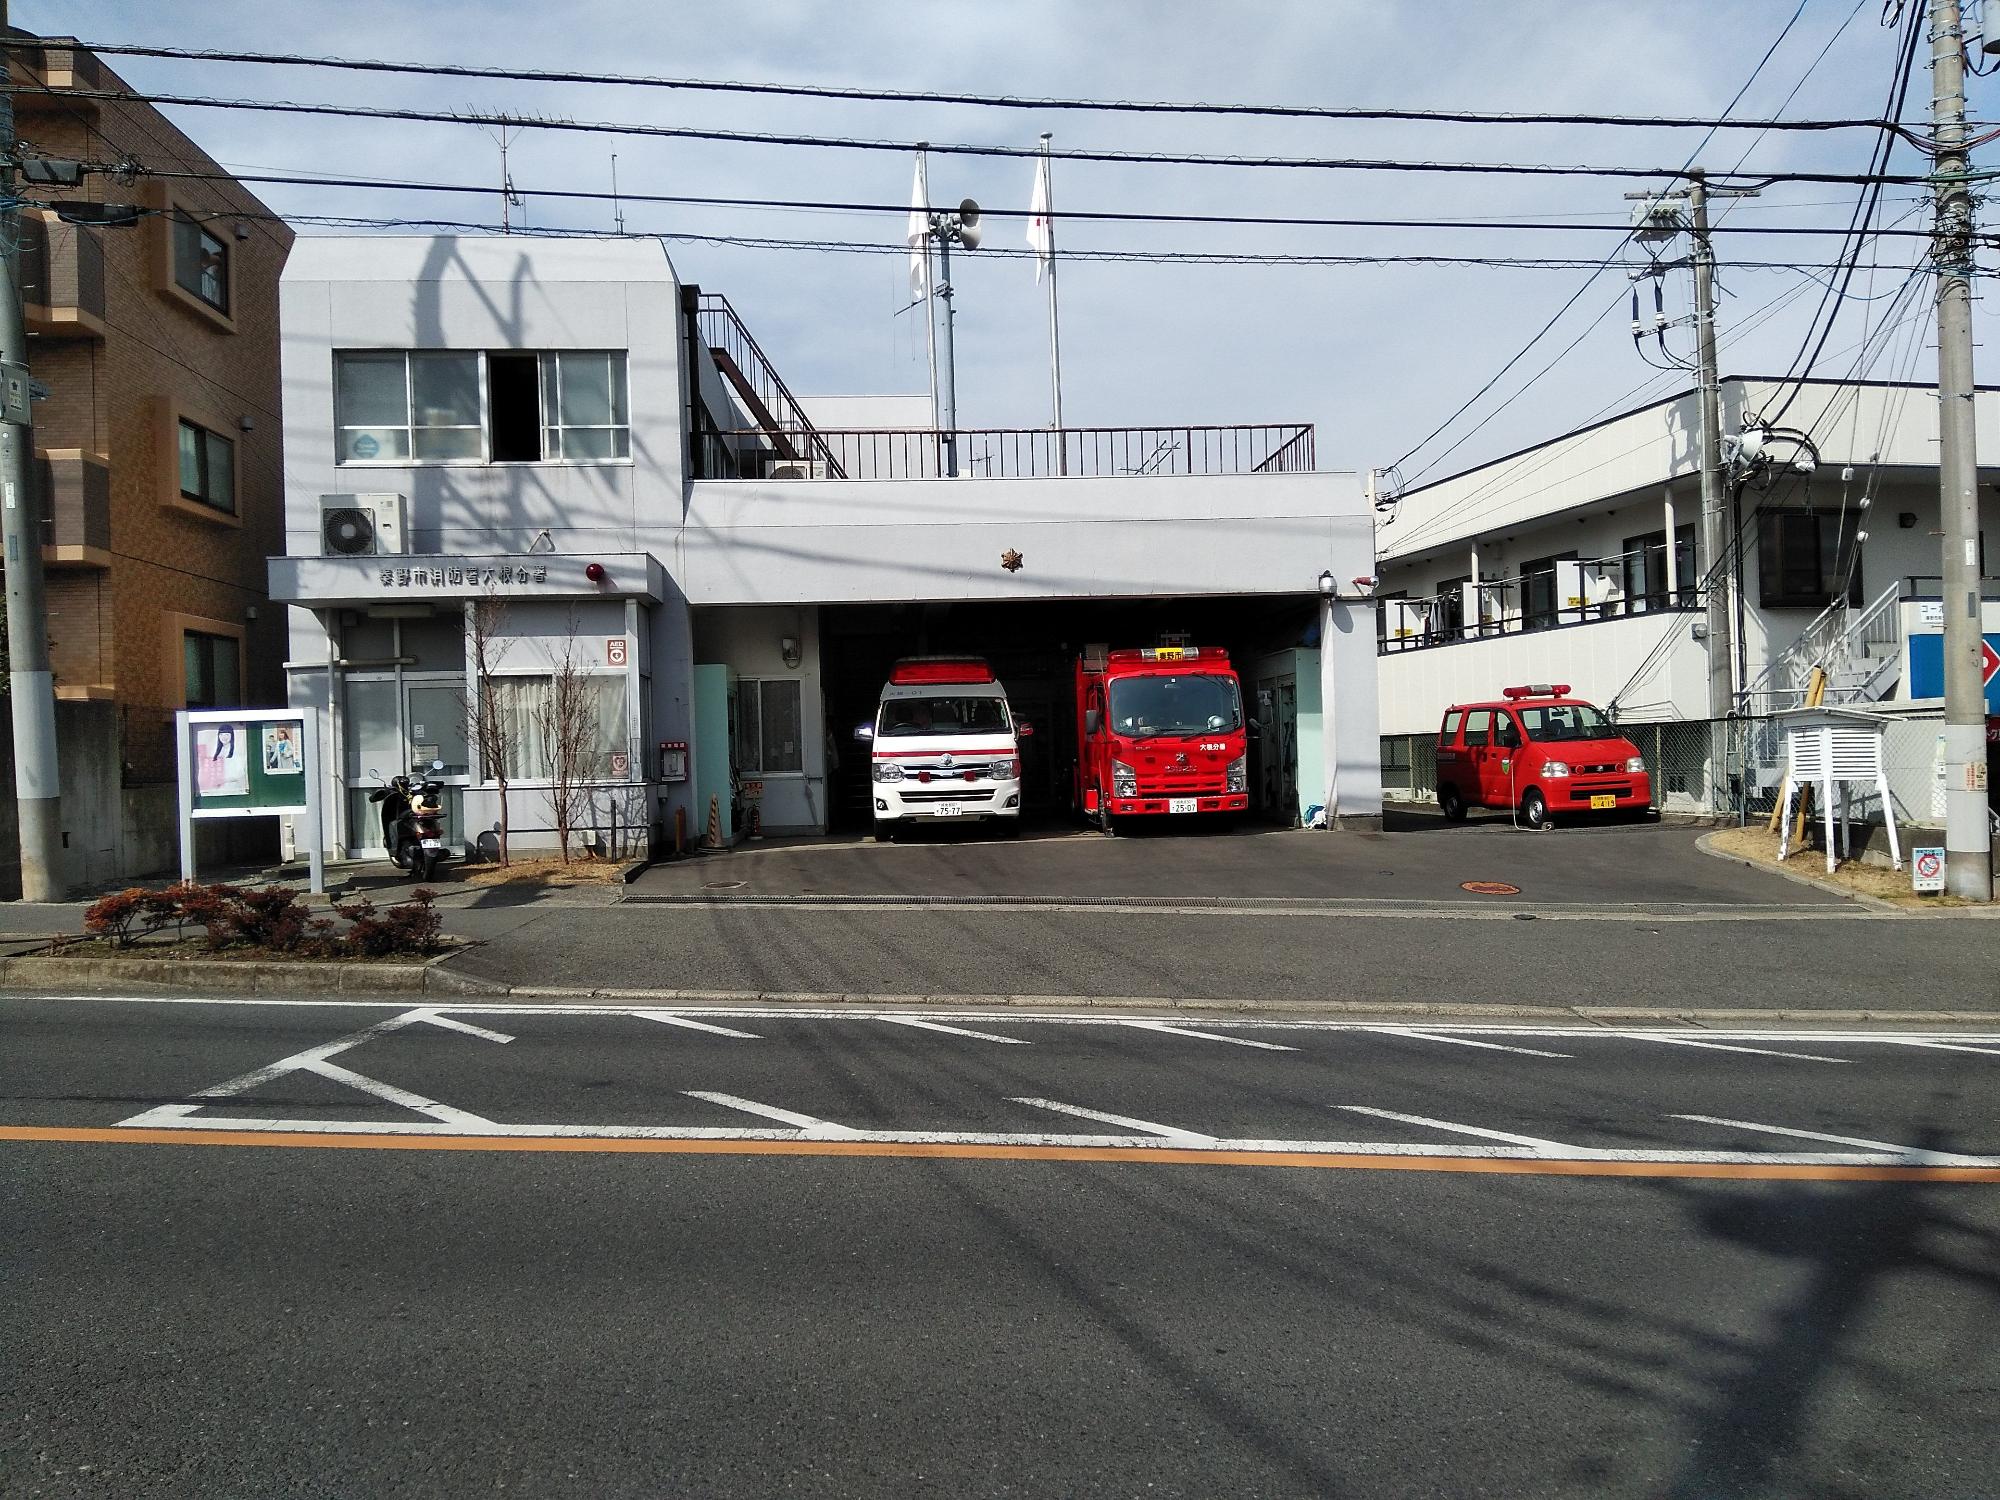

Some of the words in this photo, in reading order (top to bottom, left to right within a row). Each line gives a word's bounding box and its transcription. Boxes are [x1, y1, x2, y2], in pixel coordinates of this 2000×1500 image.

[379, 565, 548, 587] 秦野市消防署大根分署
